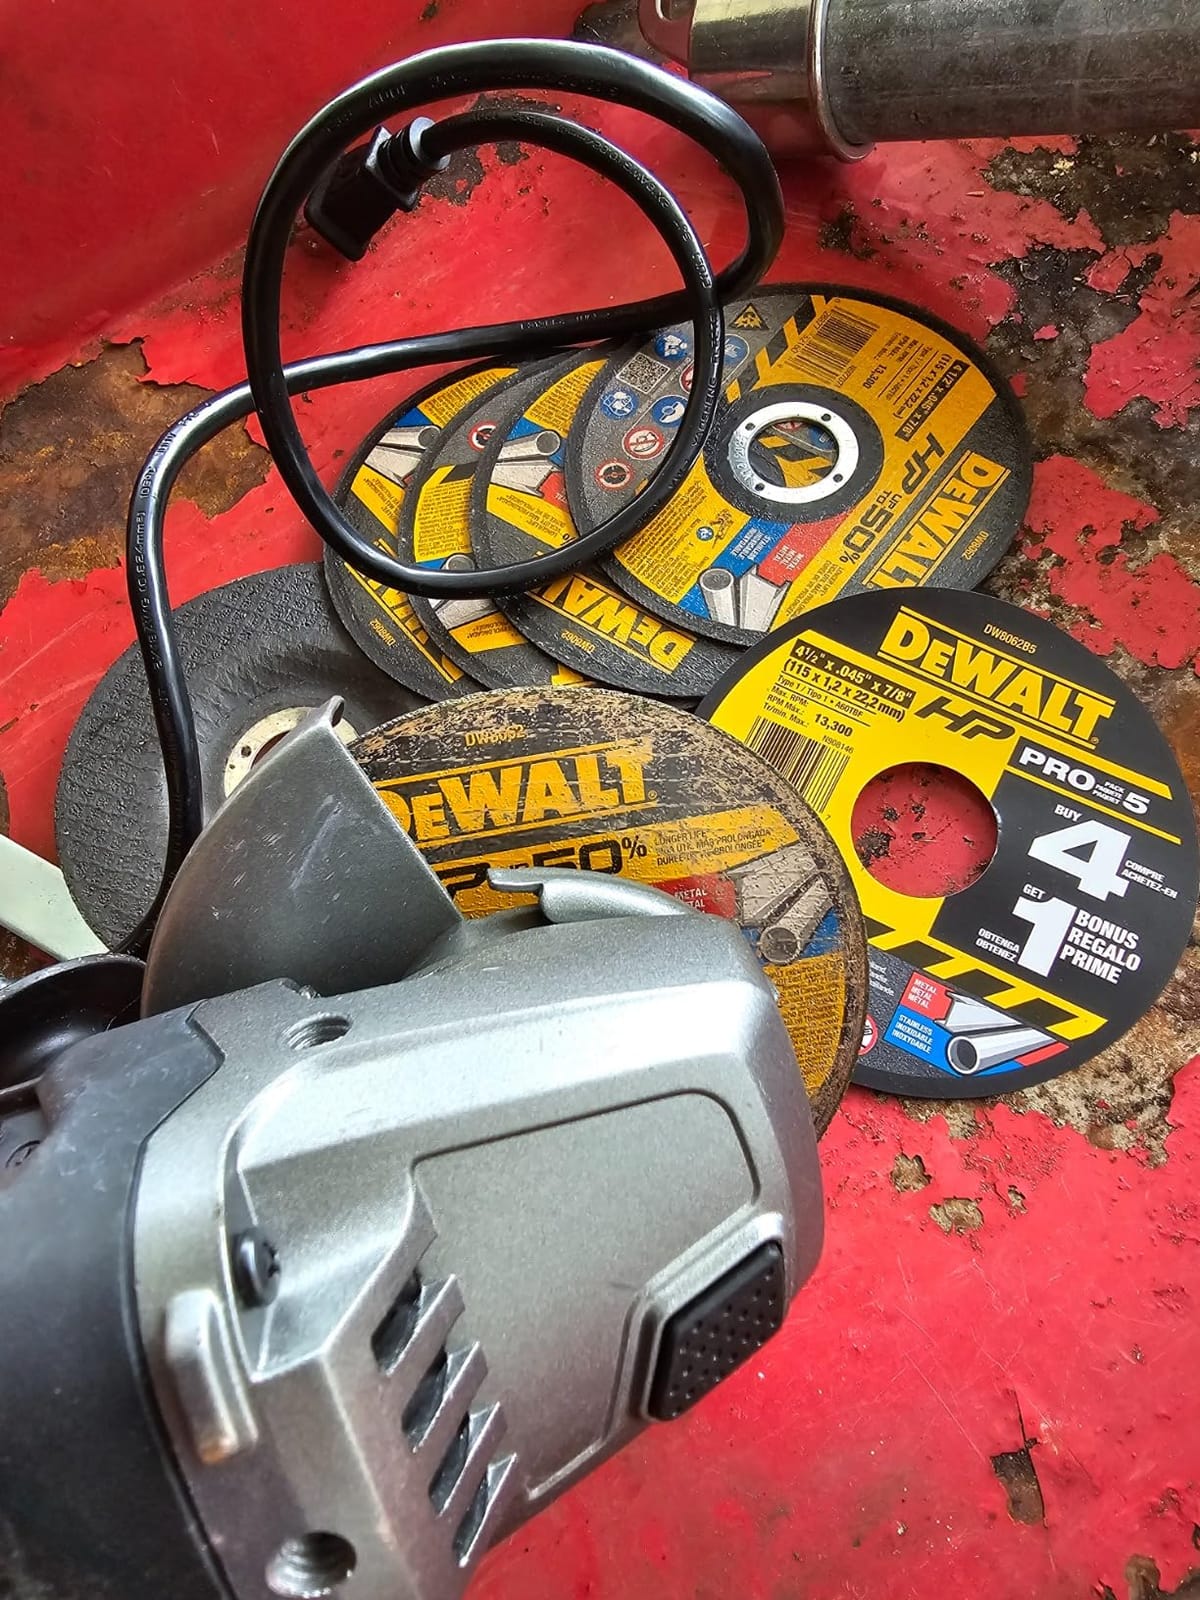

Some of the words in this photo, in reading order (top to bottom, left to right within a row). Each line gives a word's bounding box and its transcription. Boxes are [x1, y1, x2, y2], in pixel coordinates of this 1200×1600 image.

[861, 361, 887, 390] 13,300
[838, 503, 894, 565] 50%
[983, 623, 1038, 654] DW8062B5
[776, 675, 796, 691] Type
[807, 687, 822, 703] Tipo
[783, 658, 810, 678] (115
[823, 677, 841, 694] 1,2
[824, 659, 832, 671] x
[835, 665, 873, 685] .045"
[872, 680, 881, 692] x
[883, 683, 913, 703] 7/8"
[767, 694, 784, 707] RPM
[772, 686, 789, 699] Max.
[789, 692, 810, 707] RPM:
[814, 713, 853, 737] 13,300
[822, 735, 854, 754] N908146
[1019, 747, 1096, 792] PRO
[1122, 791, 1151, 815] 5
[1105, 780, 1125, 793] PACK
[1054, 804, 1083, 822] BUY
[1027, 819, 1132, 901] 4
[1125, 859, 1165, 883] COMPRE
[1022, 883, 1046, 900] GET
[1121, 868, 1178, 899] ACHETEZ-EN
[978, 927, 1020, 953] OBTENGA
[1012, 896, 1077, 978] 1
[1075, 909, 1139, 949] BONUS
[975, 937, 1017, 963] OBTENEZ
[1068, 926, 1142, 972] REGALO
[1059, 945, 1122, 985] PRIME
[909, 985, 933, 1001] METAL
[912, 978, 938, 994] METAL
[906, 992, 930, 1008] METAL
[897, 1013, 933, 1035] STAINLESS
